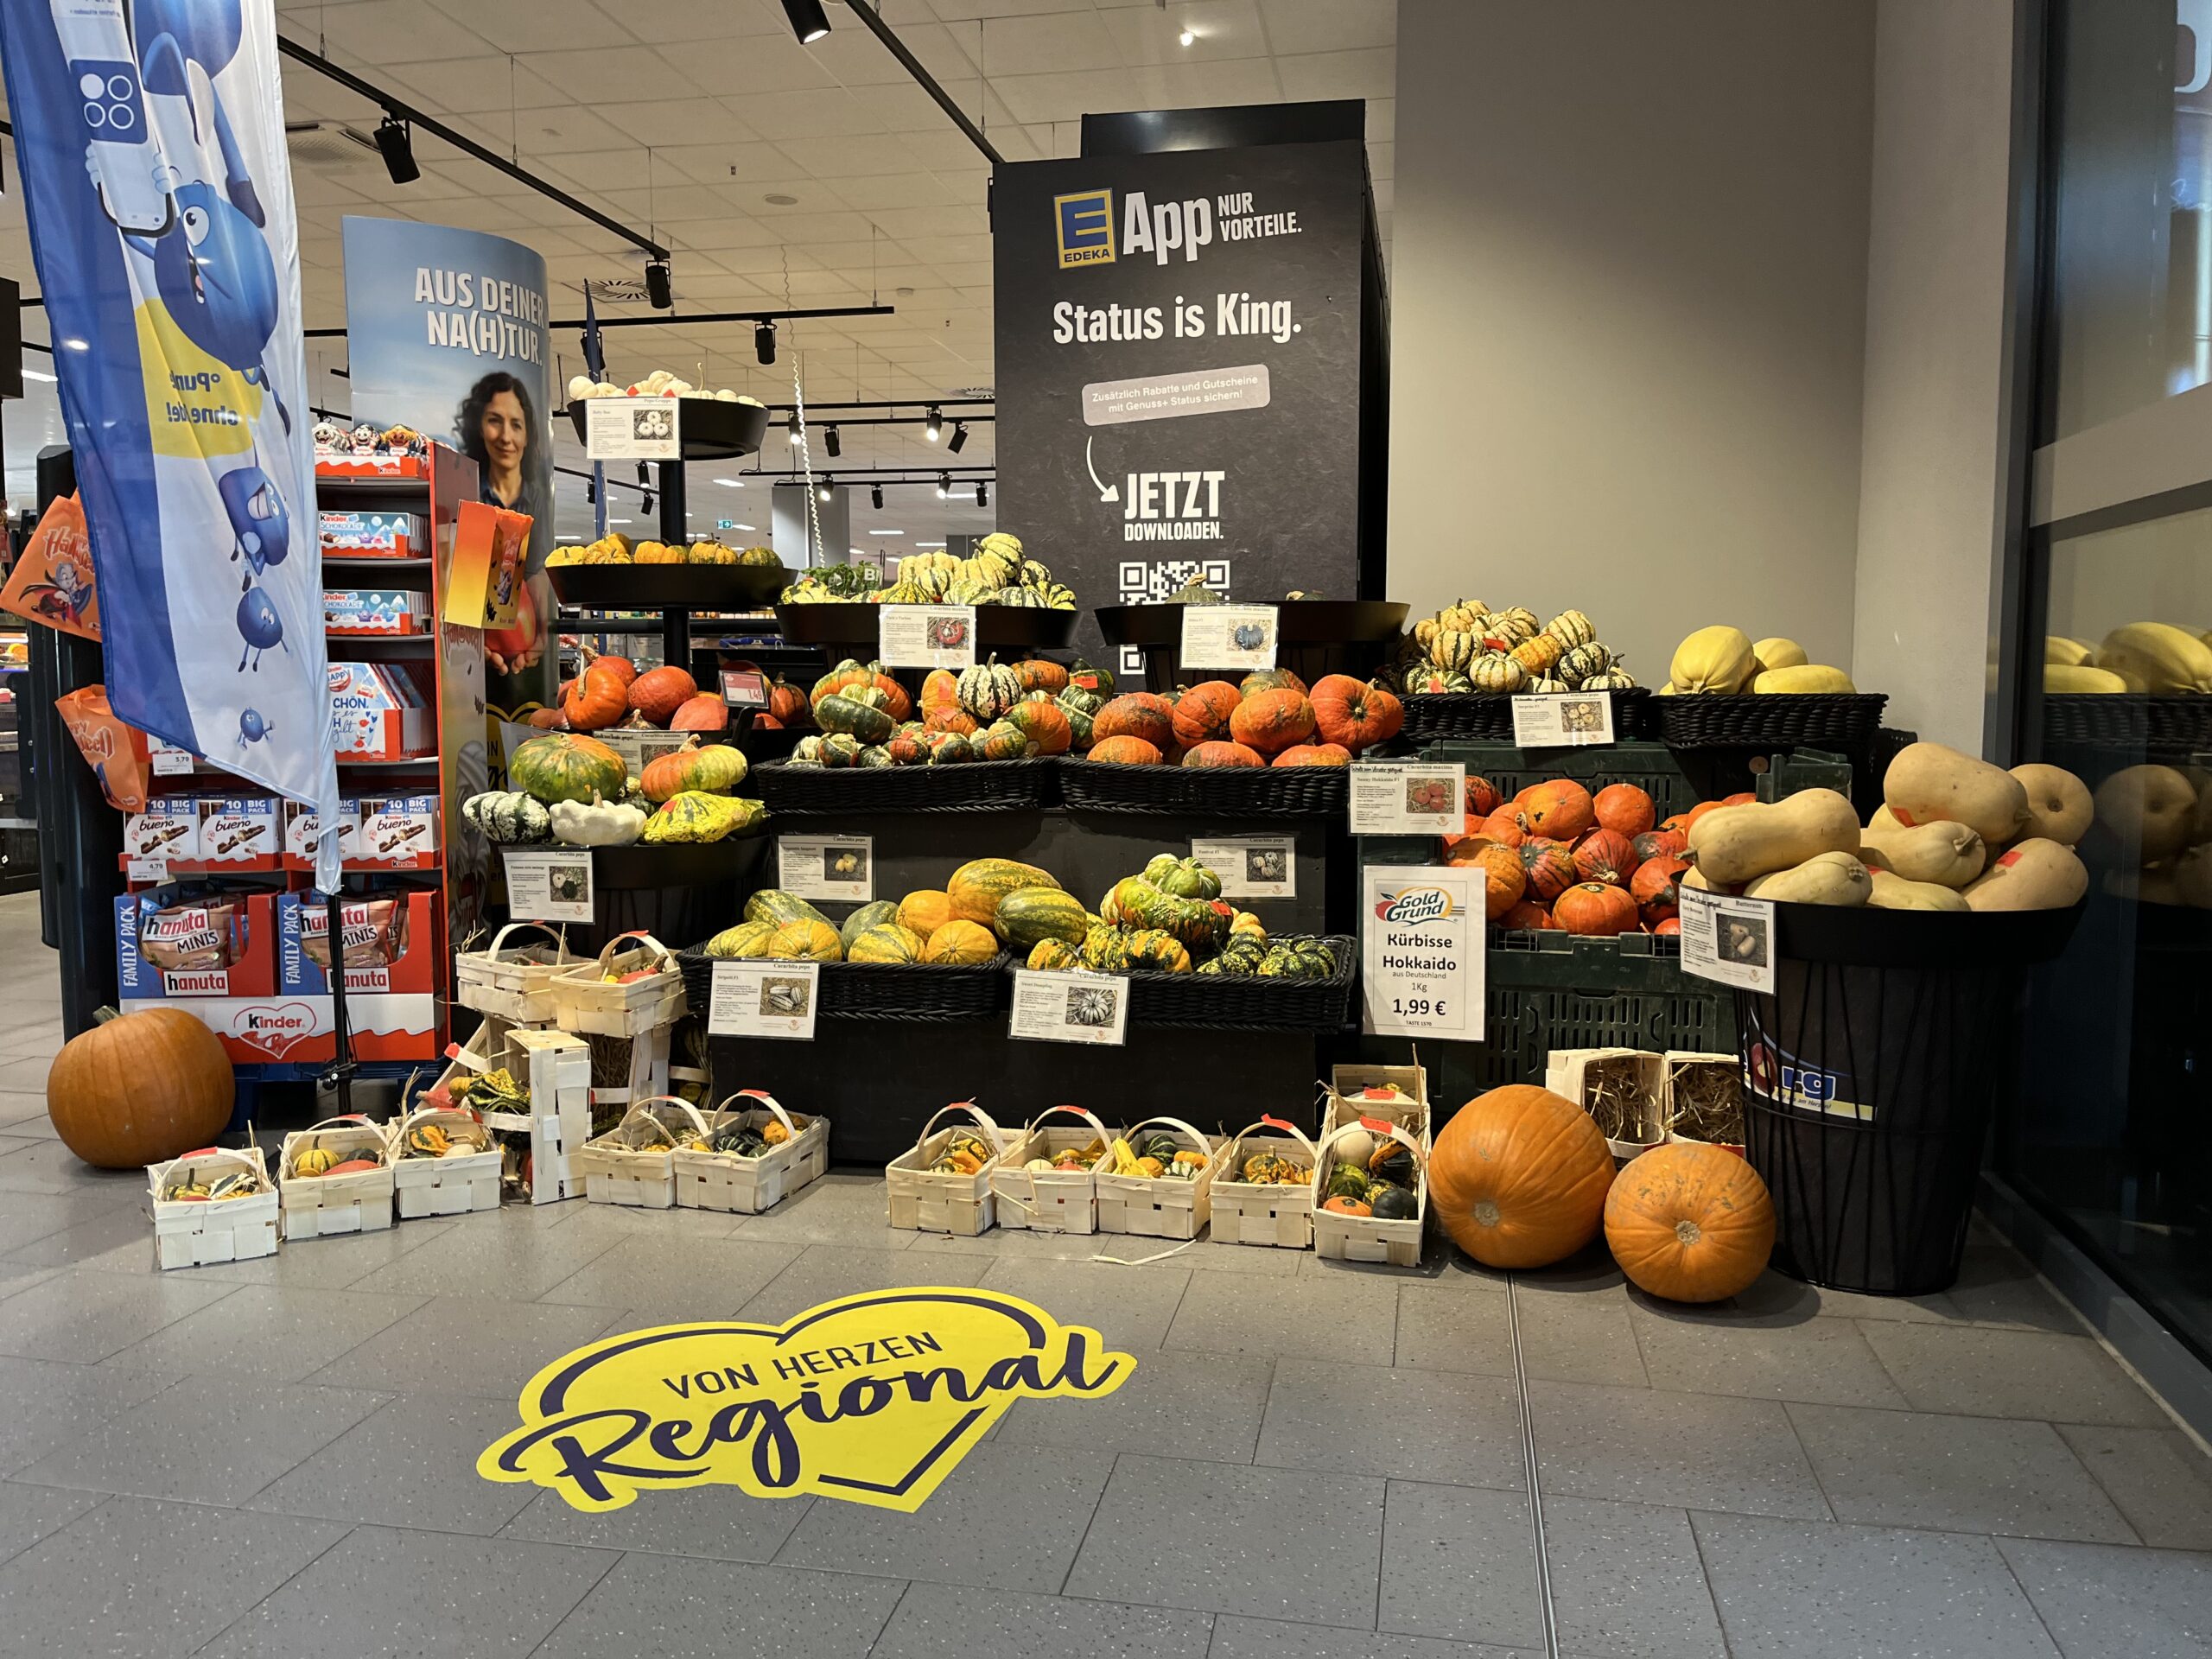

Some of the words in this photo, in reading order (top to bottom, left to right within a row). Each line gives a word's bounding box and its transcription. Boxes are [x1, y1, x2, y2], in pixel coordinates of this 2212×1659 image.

[1217, 192, 1255, 218] NUR
[1123, 191, 1213, 265] App
[1219, 212, 1302, 242] VORTEILE.
[1064, 247, 1110, 264] EDEKA
[415, 267, 474, 308] AUS
[481, 276, 544, 329] DEINER
[1052, 301, 1164, 345] Status
[1174, 296, 1205, 338] is
[1217, 292, 1302, 344] King.
[427, 310, 543, 366] NA(H)TUR.
[1091, 387, 1141, 403] Zusätzlich
[1142, 383, 1180, 397] Rabatte
[1181, 380, 1201, 393] und
[1202, 375, 1259, 391] Gutscheine
[1108, 402, 1124, 414] mit
[1125, 397, 1168, 412] Genuss+
[1170, 393, 1202, 407] Status
[1203, 388, 1243, 402] sichern!
[1124, 471, 1225, 519] JETZT
[1124, 521, 1224, 542] DOWNLOADEN.
[333, 696, 369, 709] CHÖN.
[150, 800, 166, 810] 10
[172, 799, 189, 808] BIG
[227, 800, 242, 810] 10
[389, 800, 404, 809] 10
[140, 820, 175, 831] bueno
[216, 820, 251, 831] bueno
[378, 820, 412, 831] bueno
[1398, 891, 1440, 908] Gold
[120, 905, 137, 937] PACK
[283, 904, 300, 934] PACK
[1386, 901, 1444, 922] Grund
[147, 912, 206, 935] hanuta
[177, 931, 219, 954] MINIS
[1388, 933, 1452, 948] Kürbisse
[122, 940, 138, 987] FAMILY
[284, 938, 301, 984] FAMILY
[1382, 956, 1457, 970] Hokkaido
[168, 974, 226, 991] hanuta
[330, 970, 386, 988] anuta
[1412, 982, 1427, 992] 1Kg
[1393, 998, 1430, 1016] 1,99
[1435, 1001, 1446, 1015] €
[662, 1363, 760, 1400] VON
[774, 1331, 944, 1380] HERZEN
[498, 1332, 1121, 1502] Regional
